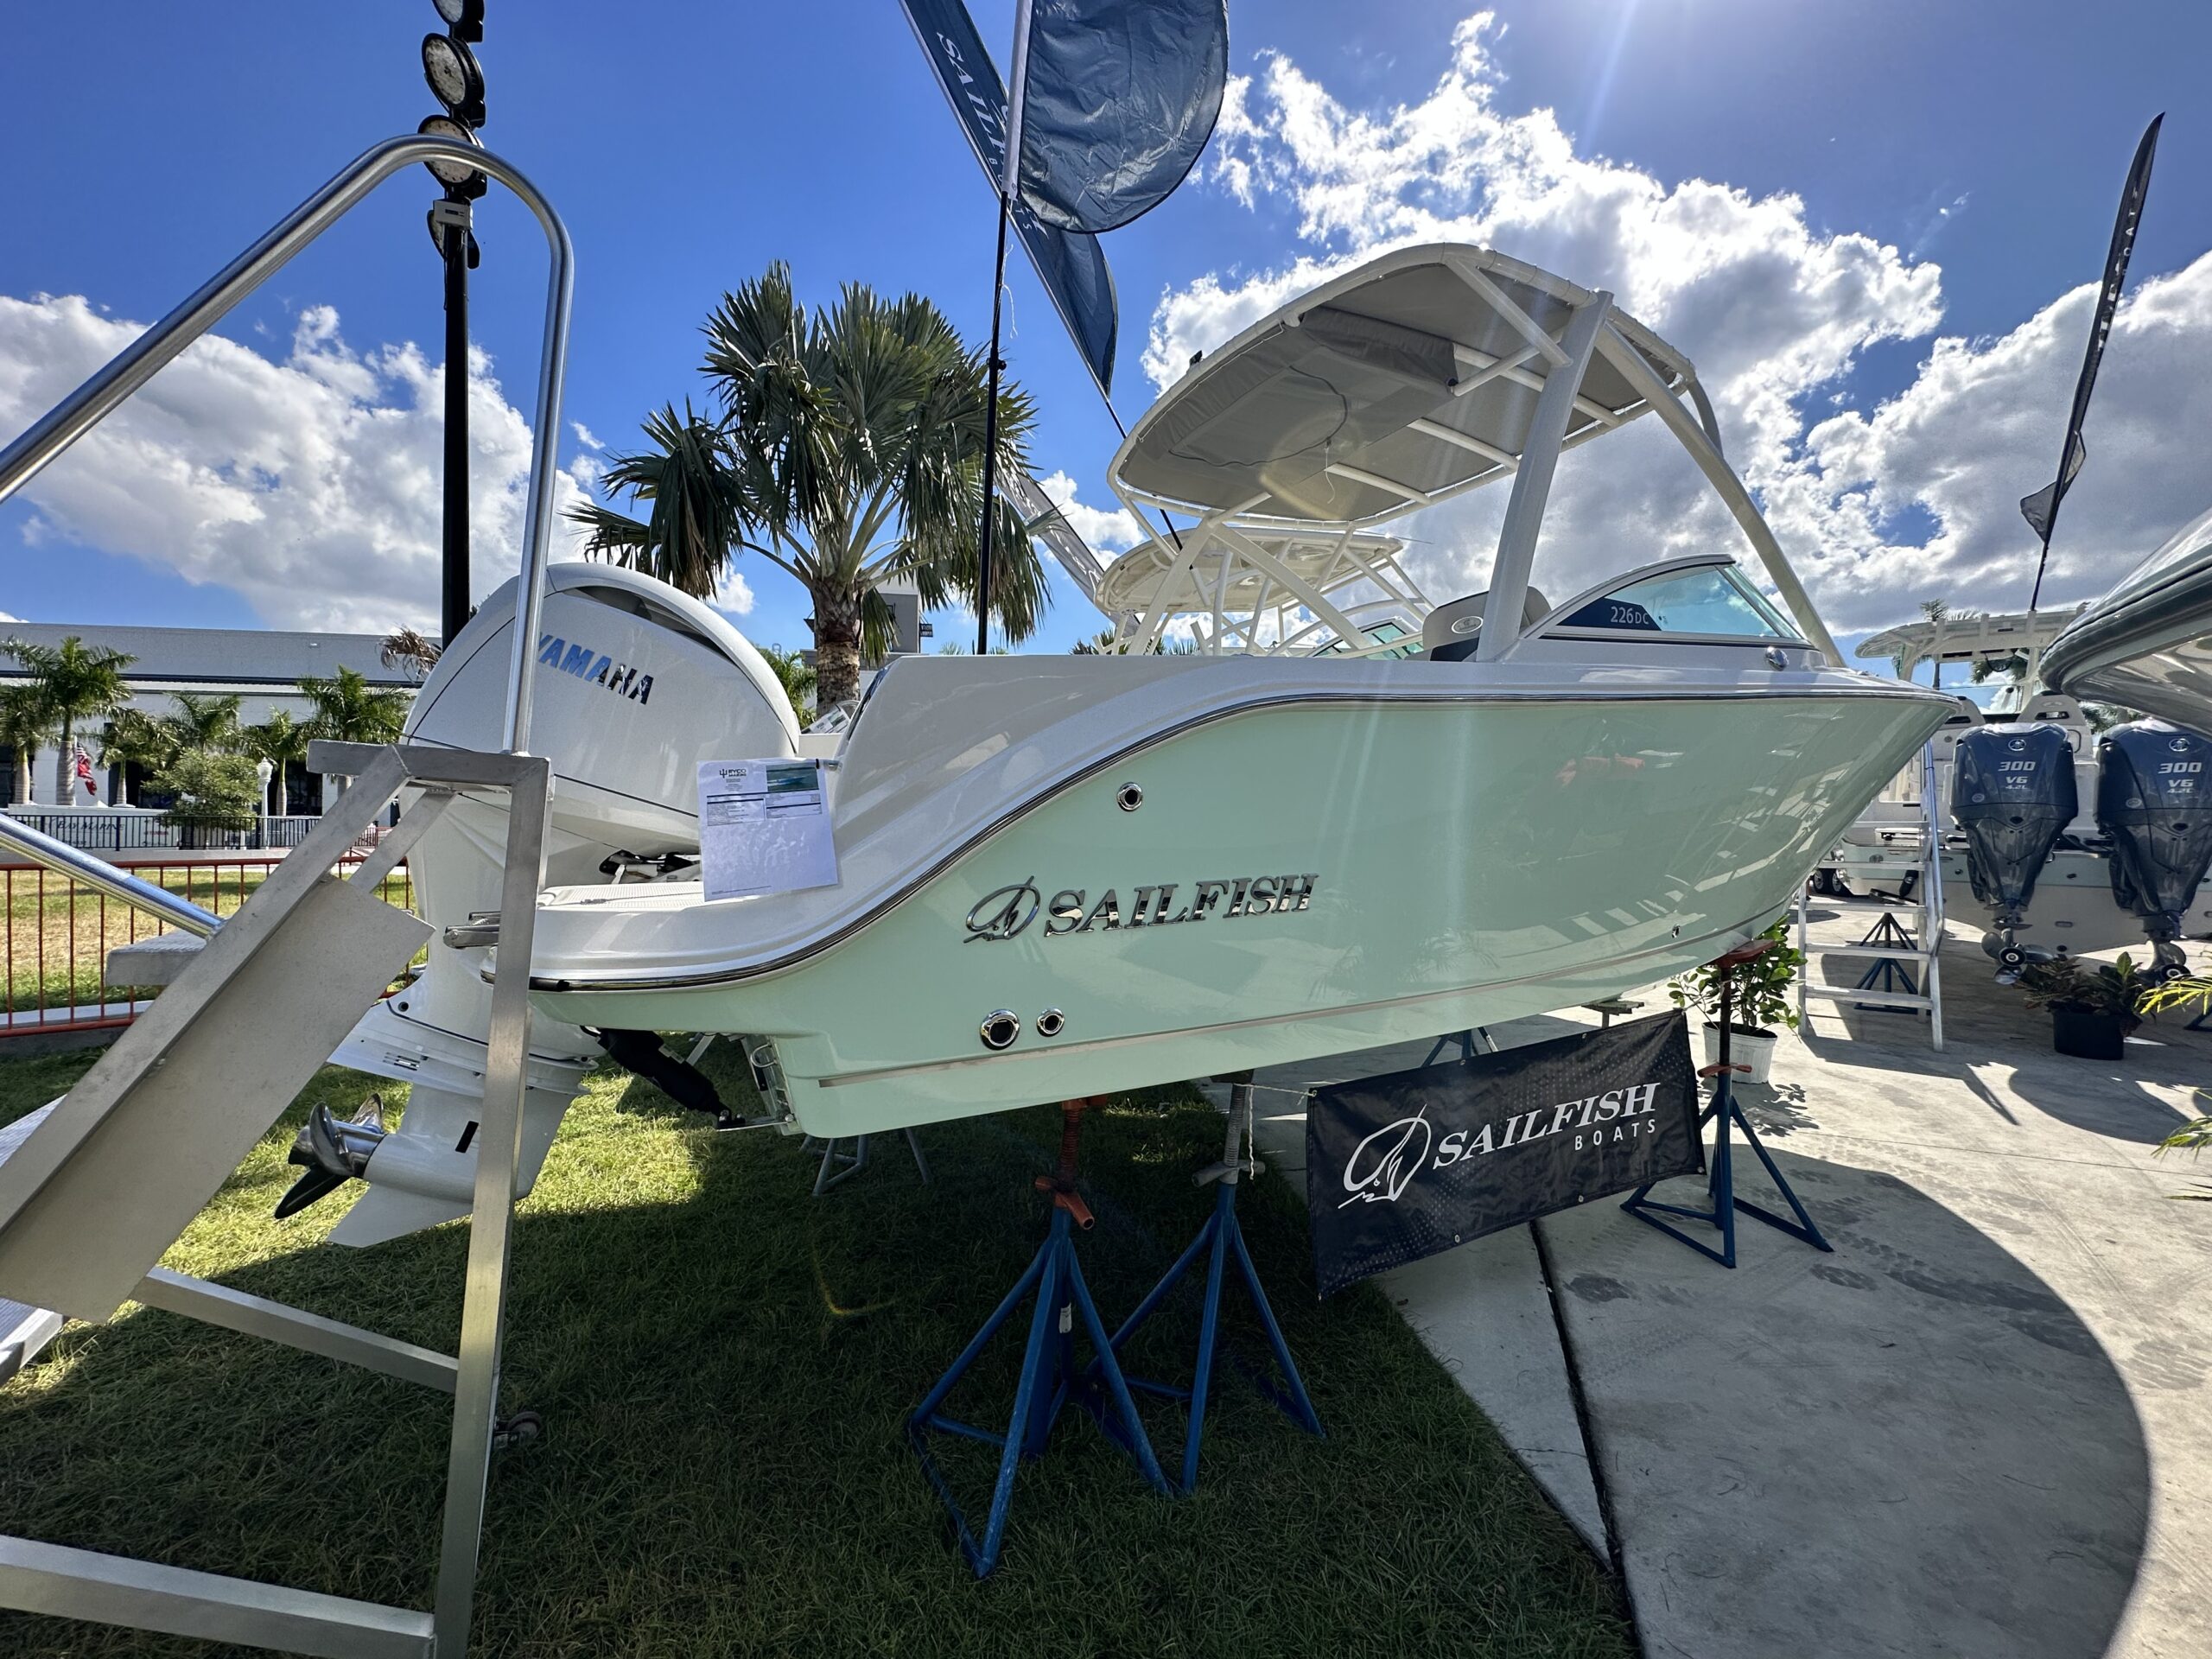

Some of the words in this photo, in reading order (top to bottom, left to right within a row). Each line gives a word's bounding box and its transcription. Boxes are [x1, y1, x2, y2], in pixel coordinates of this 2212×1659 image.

[988, 156, 1033, 231] BOTS
[1998, 760, 2036, 772] 300
[2158, 762, 2202, 774] 300
[2168, 779, 2195, 787] V6
[1043, 873, 1319, 938] SAILFISH
[1433, 1082, 1661, 1170] SAILFISH
[1574, 1119, 1656, 1151] BOATS
